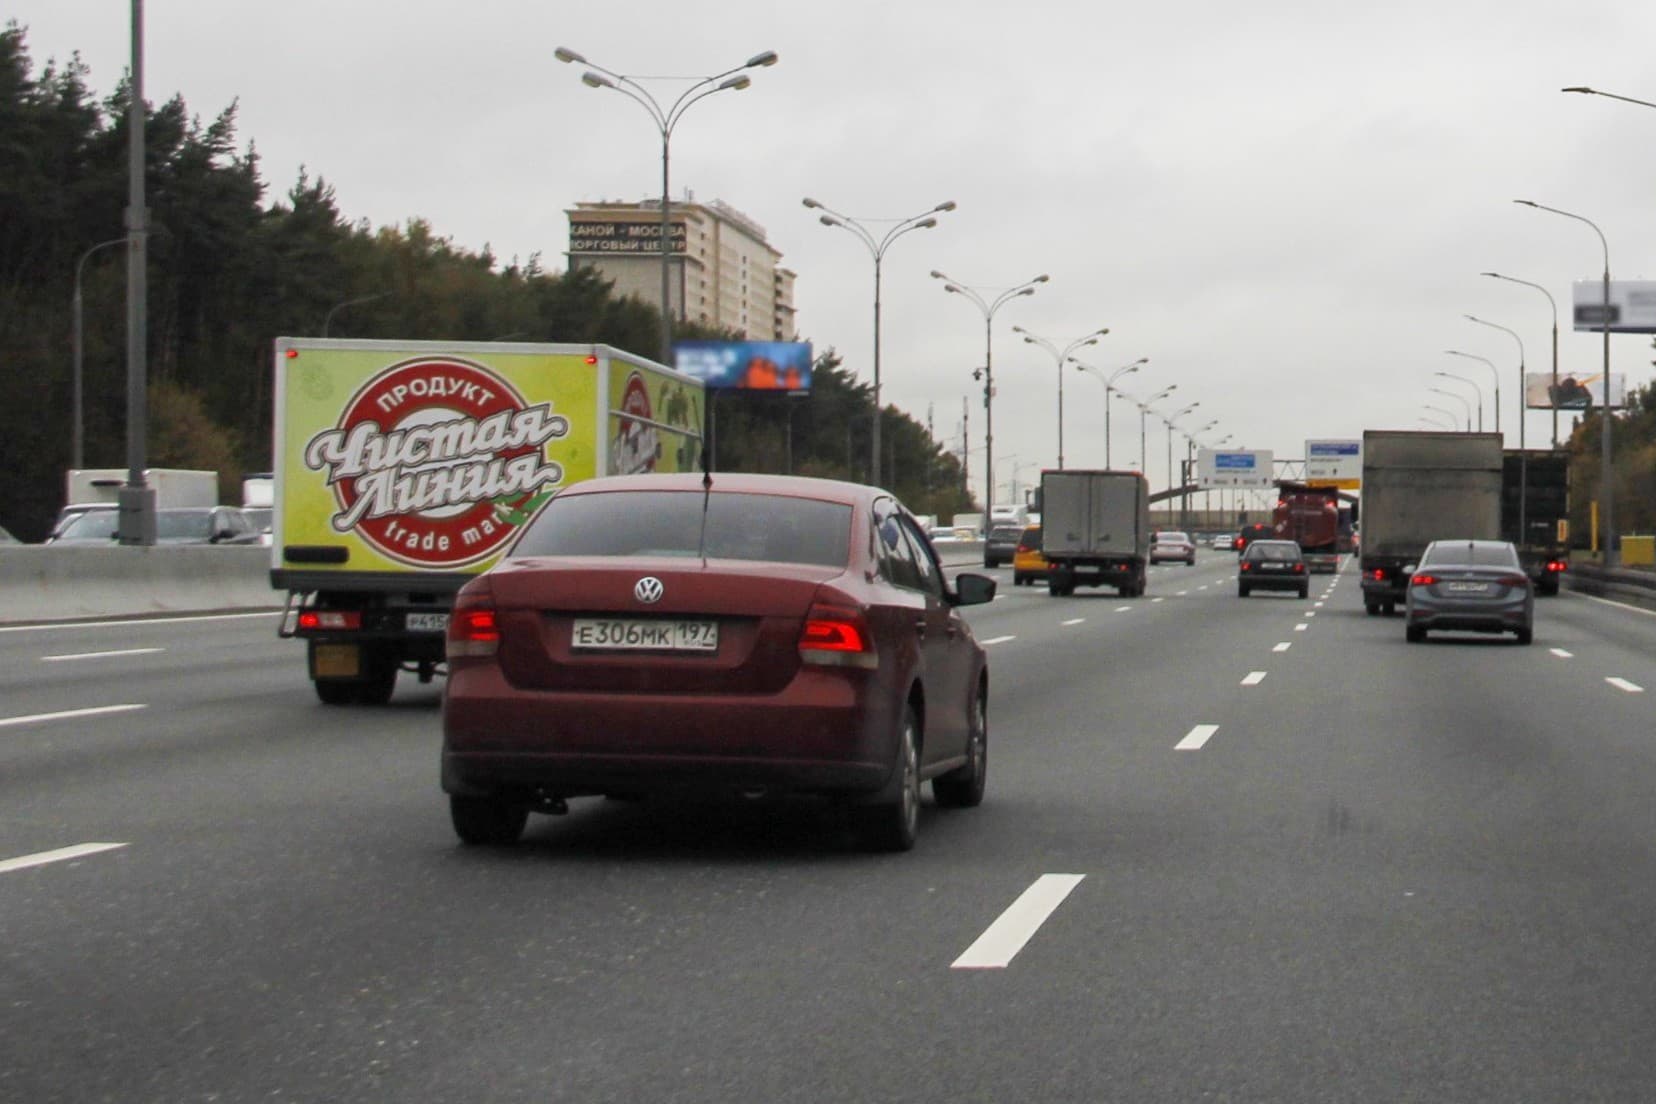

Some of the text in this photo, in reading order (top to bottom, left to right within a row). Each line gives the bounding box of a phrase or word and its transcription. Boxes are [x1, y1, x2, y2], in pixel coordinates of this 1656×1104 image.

[628, 225, 687, 237] МОСВА
[643, 240, 687, 252] ЦЕТР
[376, 376, 495, 412] ПРОДУКТ
[305, 403, 568, 486] Чистая
[331, 452, 562, 532] Линия
[384, 502, 514, 550] trade mark
